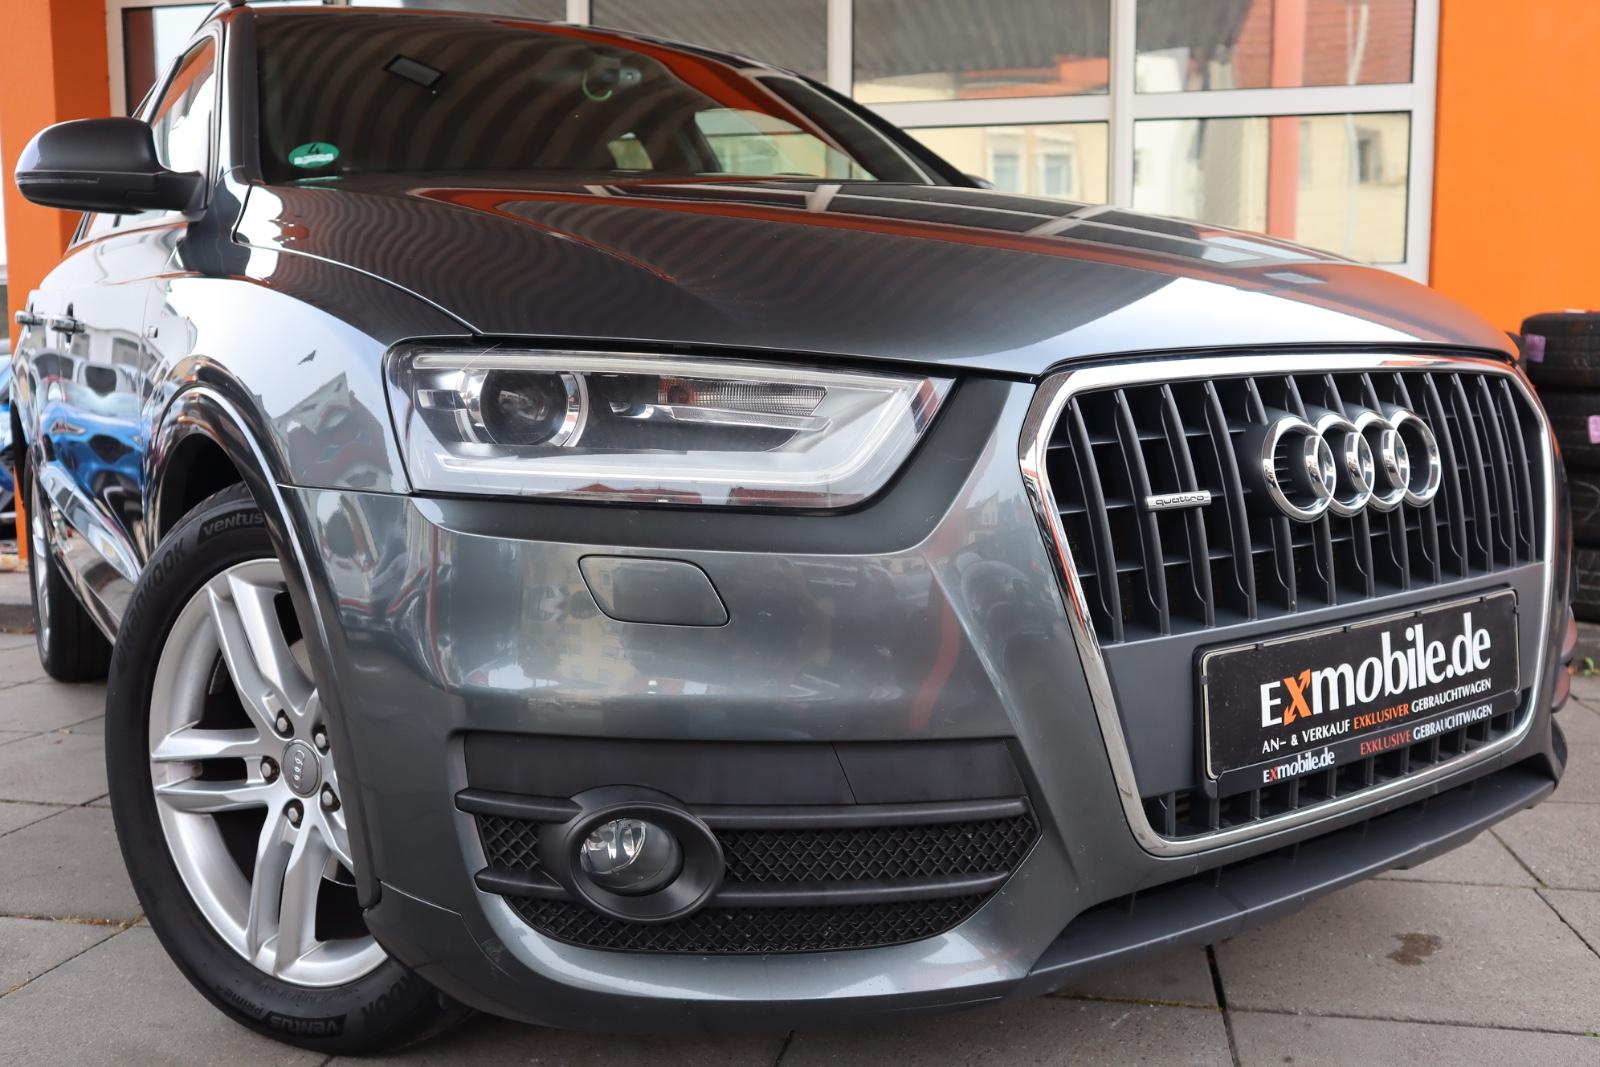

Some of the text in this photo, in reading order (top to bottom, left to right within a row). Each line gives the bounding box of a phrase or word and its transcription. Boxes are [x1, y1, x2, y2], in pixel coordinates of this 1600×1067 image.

[1155, 495, 1204, 506] quattro
[1260, 611, 1491, 728] EXmobile.de
[1262, 678, 1492, 754] AN- & VERKAUF EXKLUSIVER GEBRAUCHTWAGEN
[1360, 703, 1493, 756] EXKLUSIVE GEBRAUCHTWAGEN
[1263, 747, 1335, 784] EXmobile.de
